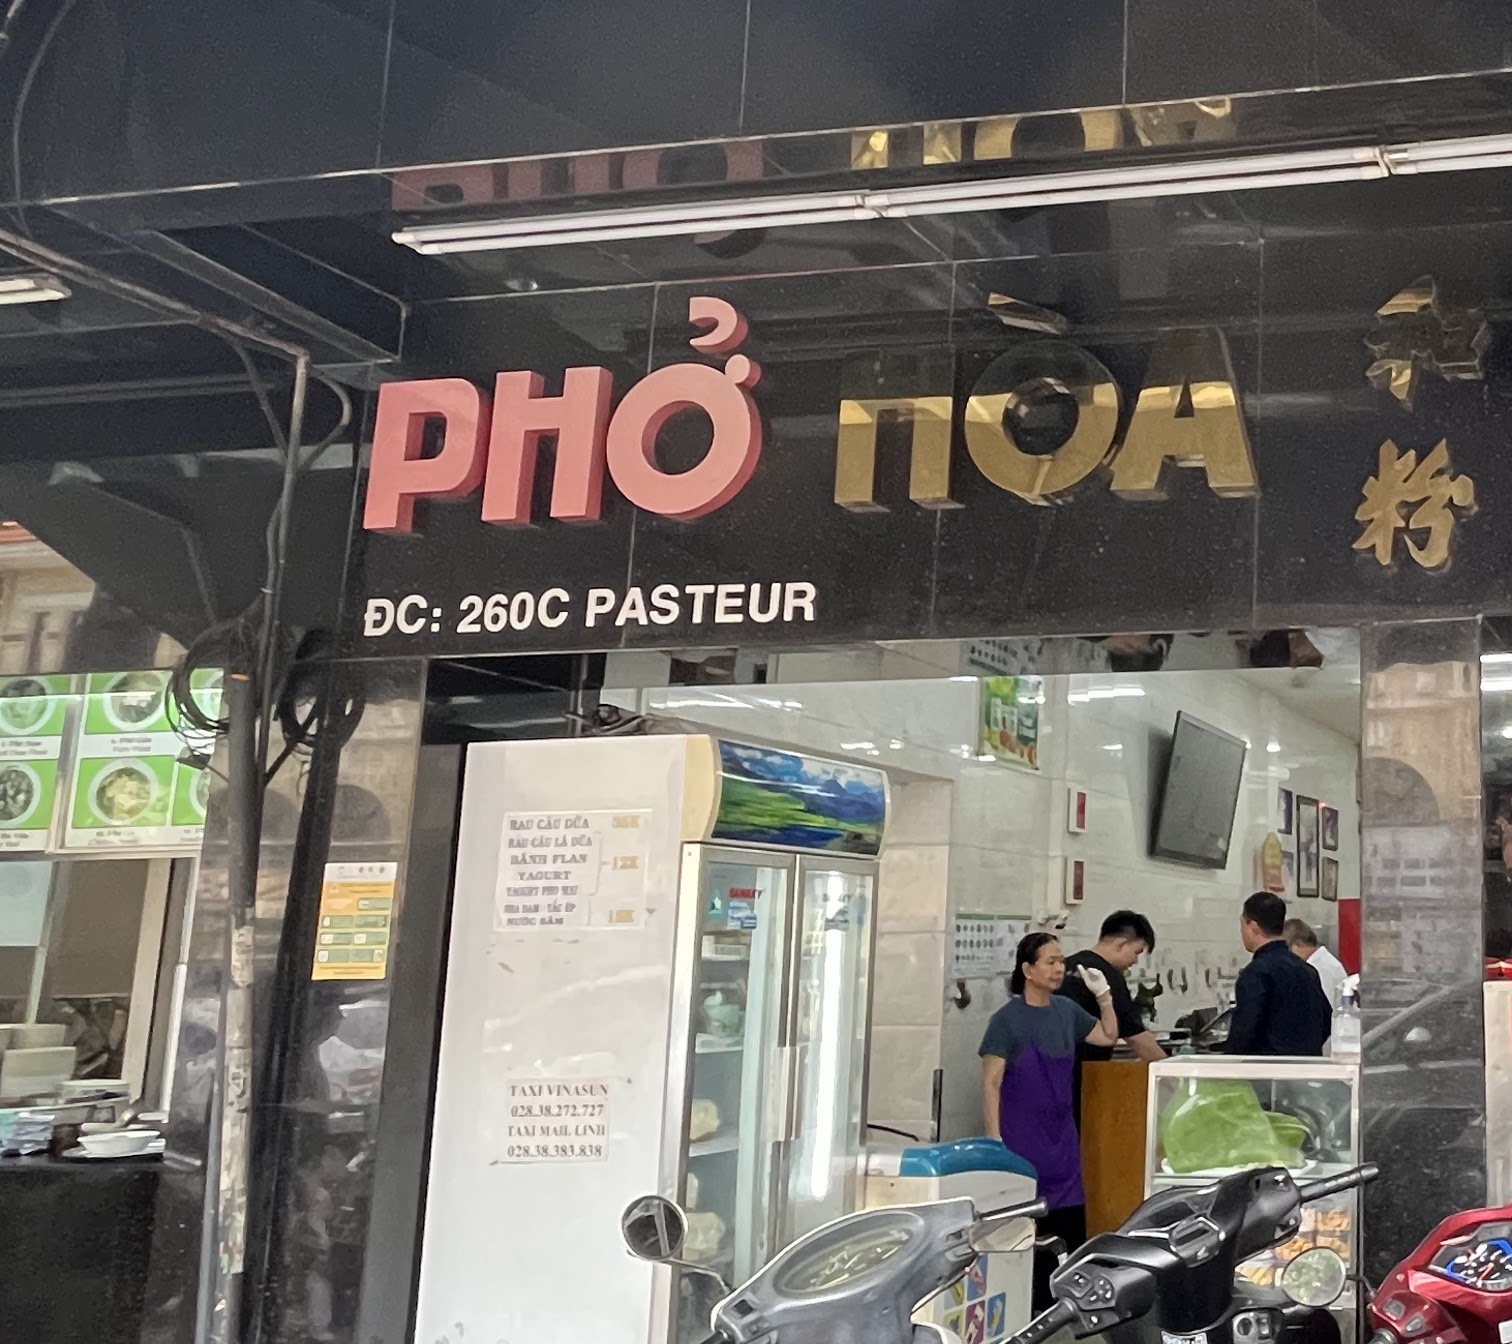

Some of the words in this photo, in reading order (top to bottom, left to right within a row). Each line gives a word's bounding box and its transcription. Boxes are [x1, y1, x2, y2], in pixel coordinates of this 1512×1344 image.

[362, 296, 763, 534] PHỞ
[364, 596, 443, 638] ĐC:
[458, 590, 570, 633] 260C
[585, 581, 818, 629] PASTEUR
[510, 1084, 542, 1096] TAXI
[508, 1125, 536, 1137] TAXI
